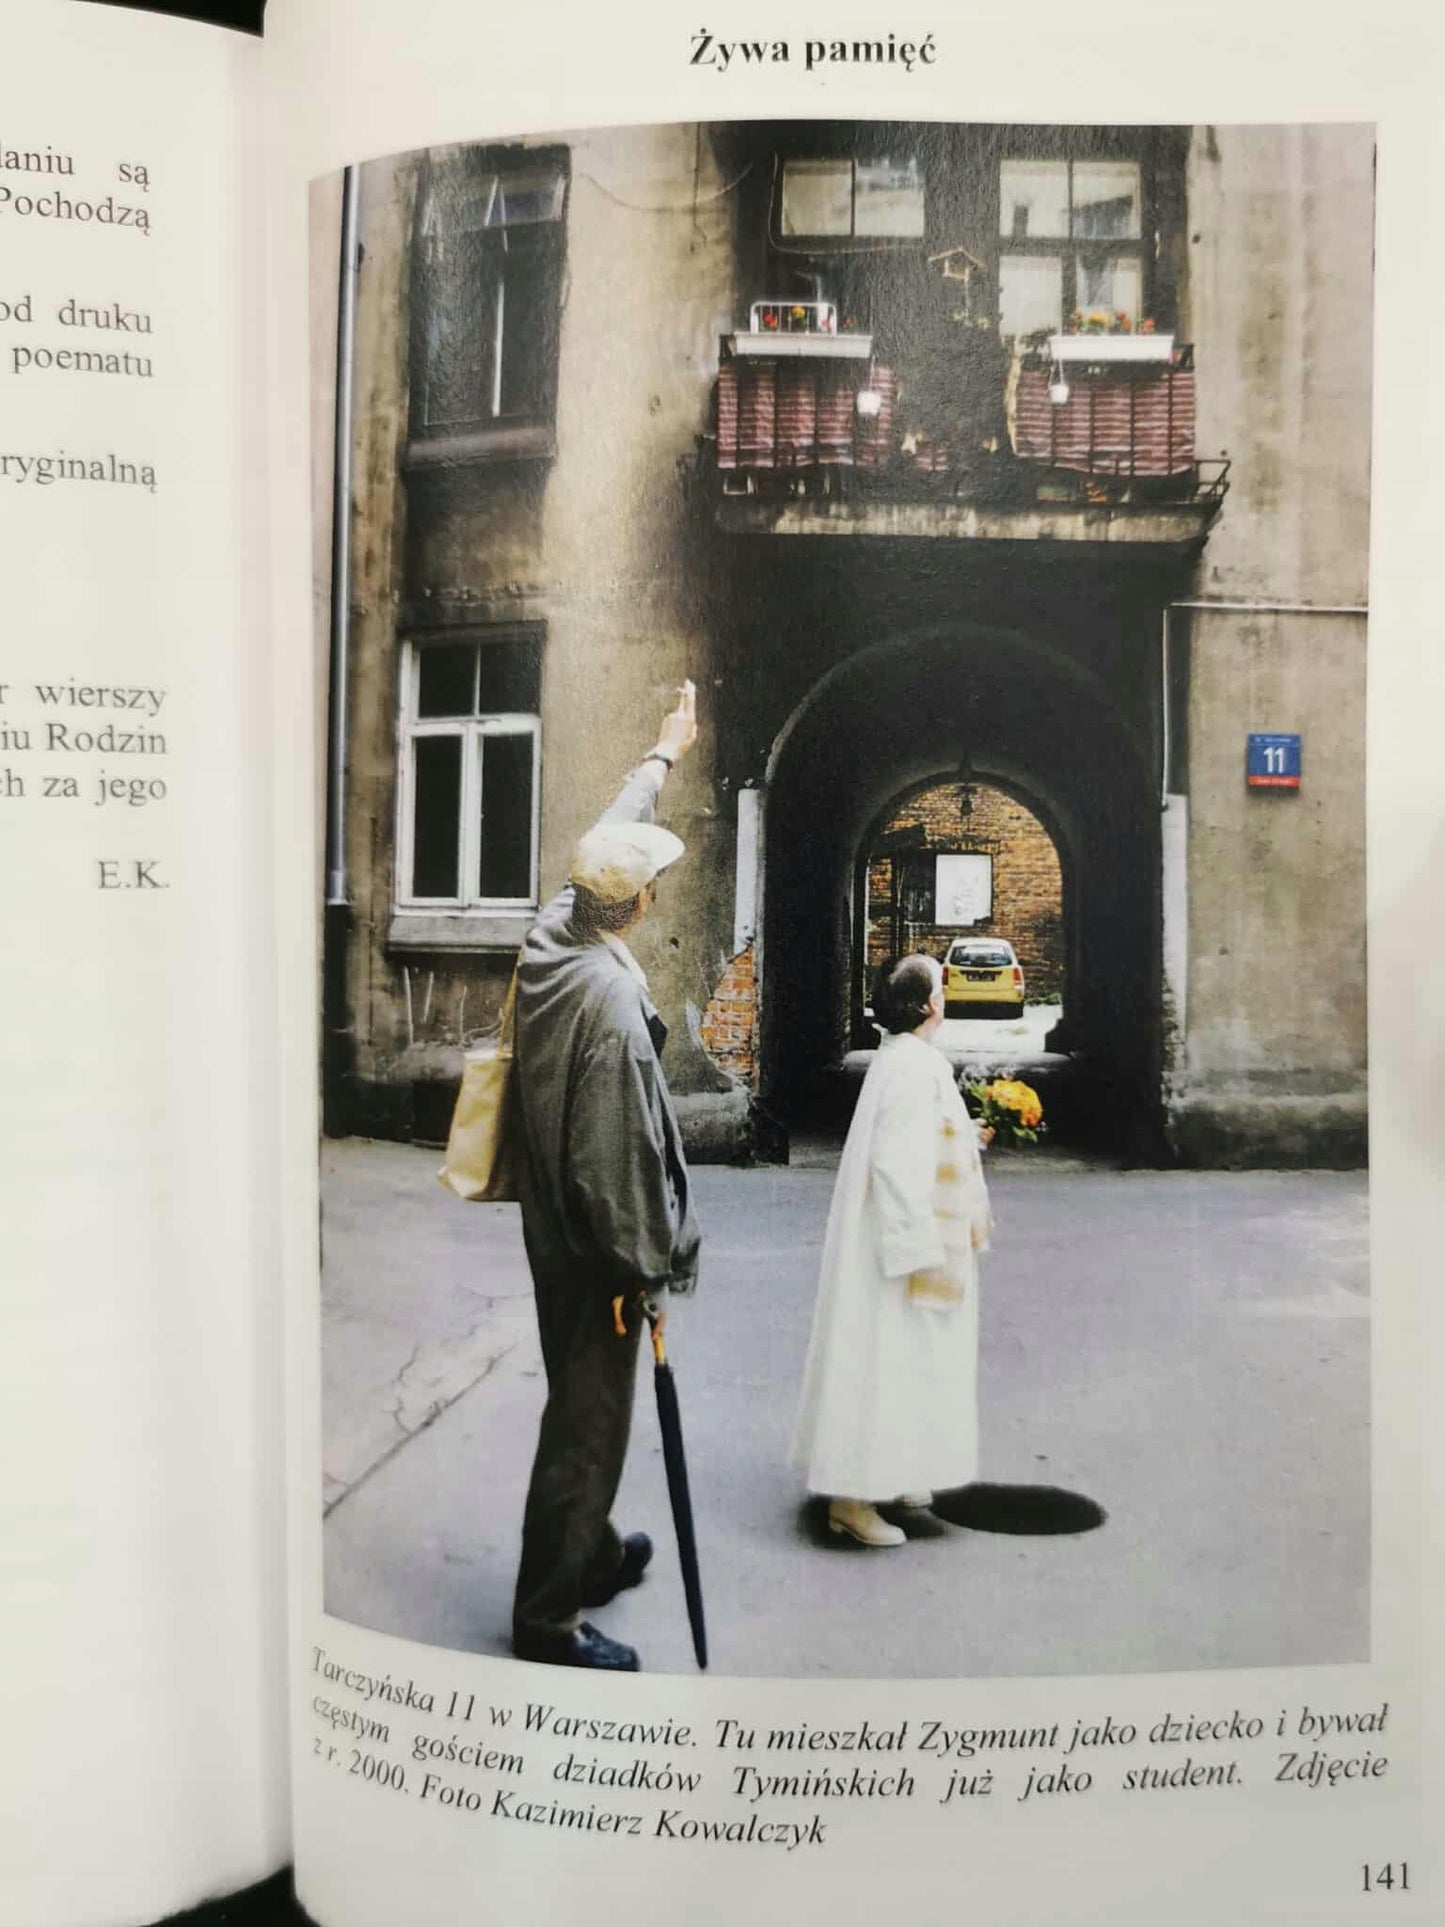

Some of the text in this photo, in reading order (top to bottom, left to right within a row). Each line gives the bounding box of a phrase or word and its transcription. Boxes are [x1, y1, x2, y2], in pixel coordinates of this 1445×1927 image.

[689, 27, 937, 73] Żywa pamięć
[0, 142, 150, 192] aniu są
[58, 299, 153, 334] druku
[10, 346, 154, 378] poematu
[0, 450, 157, 493] ryginalną
[35, 677, 166, 717] wierszy
[0, 720, 168, 755] iu Rodzin
[1263, 746, 1286, 774] 11
[43, 777, 79, 798] za
[94, 769, 167, 807] jego
[97, 860, 171, 889] E.K.
[312, 1645, 1388, 1758] Tarczyńska 11 w Warszawie. Tu mieszkał Zygmunt jako dziecko i bywał
[313, 1696, 1389, 1804] częstym gościem dziadków Tymińskich już jako student. Zdjęcie
[312, 1737, 828, 1851] z r. 2000. Foto Kazimierz Kowalczyk
[1361, 1861, 1412, 1892] 141
